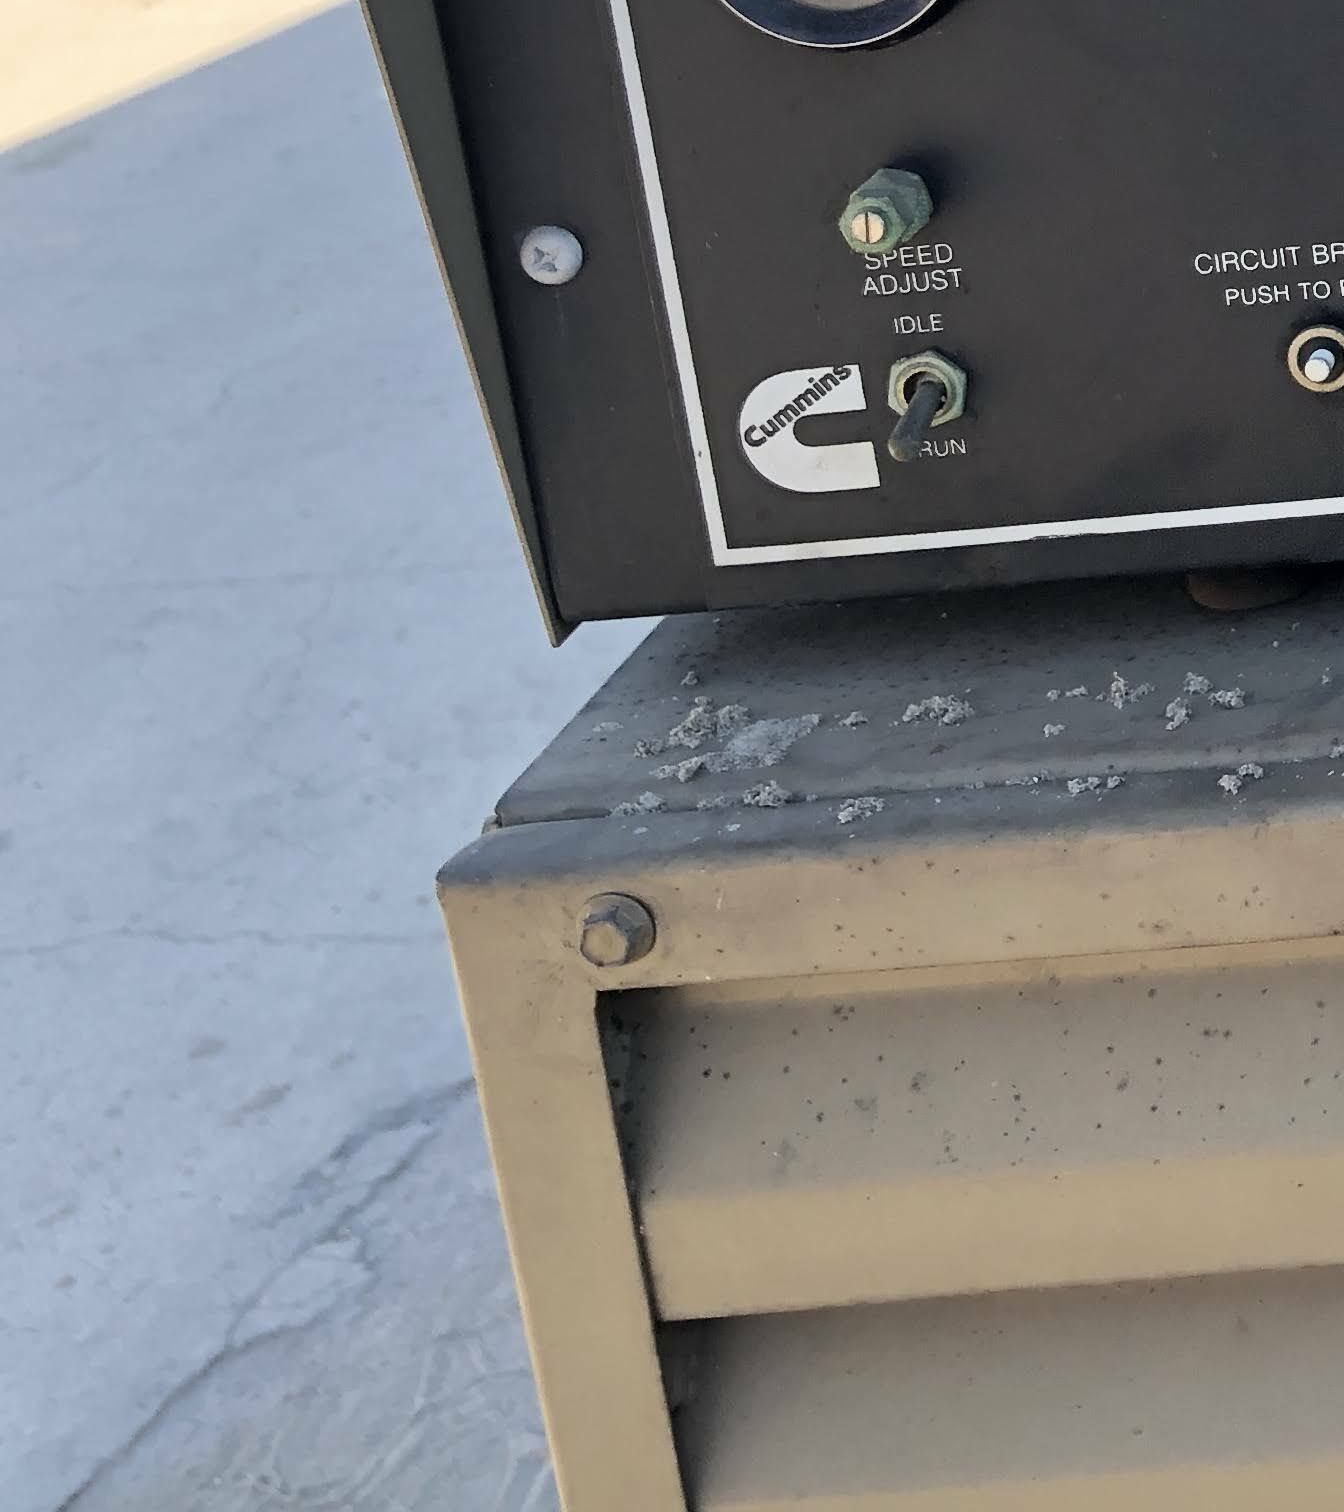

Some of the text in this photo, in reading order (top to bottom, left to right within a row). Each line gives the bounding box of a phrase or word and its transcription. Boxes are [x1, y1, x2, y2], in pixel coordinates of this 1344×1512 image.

[865, 243, 952, 270] SPEED
[1194, 246, 1301, 274] CIRCUIT
[863, 268, 962, 296] ADJUST
[1225, 285, 1290, 306] PUSH
[1298, 281, 1331, 300] TO
[894, 314, 944, 335] IDLE
[744, 365, 852, 447] Cummins
[919, 439, 968, 457] RUN
